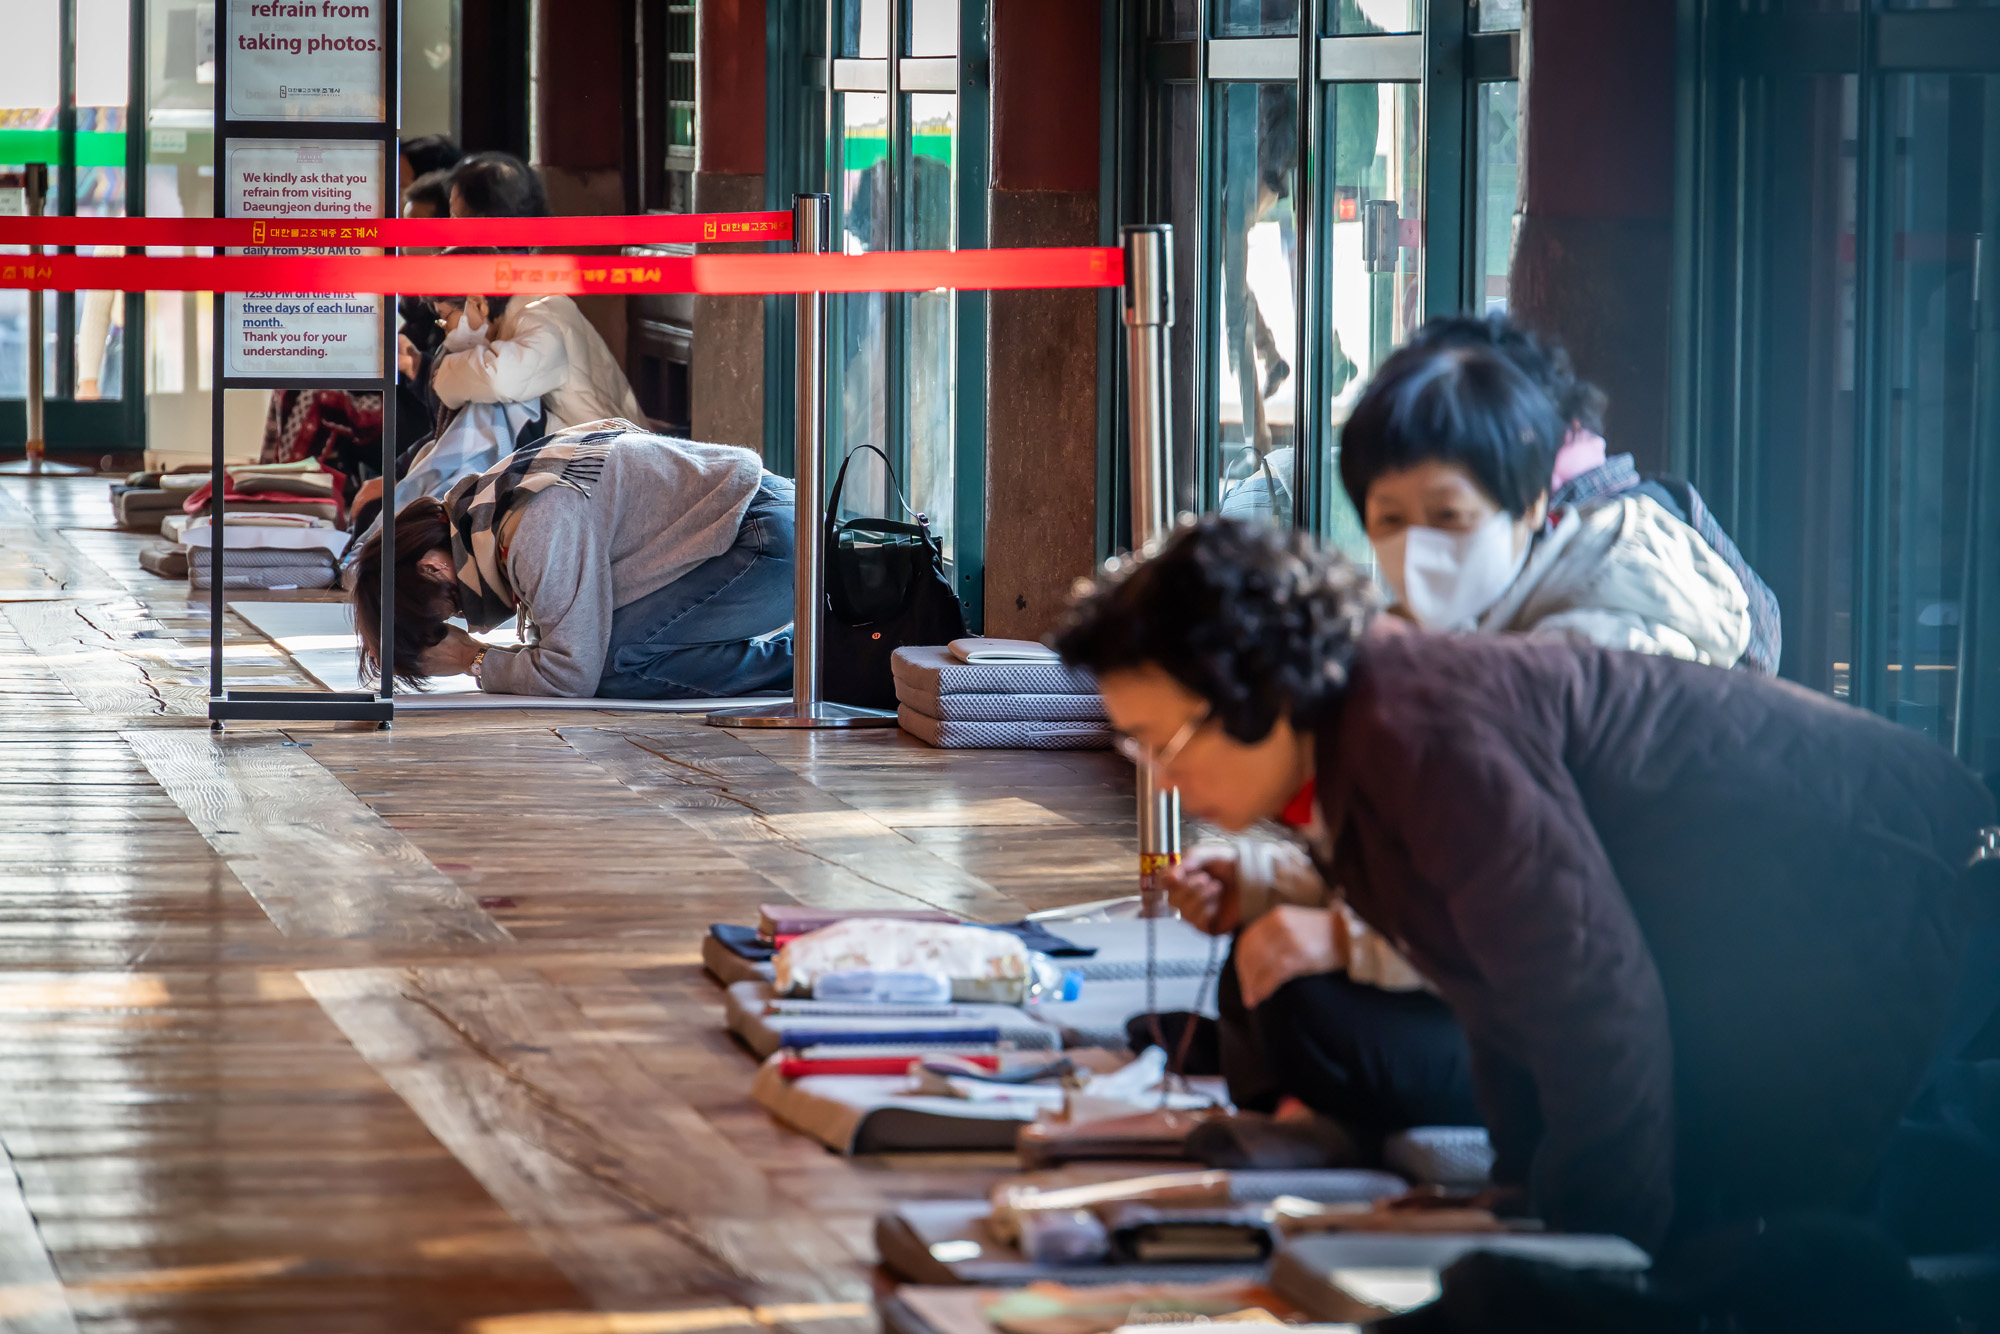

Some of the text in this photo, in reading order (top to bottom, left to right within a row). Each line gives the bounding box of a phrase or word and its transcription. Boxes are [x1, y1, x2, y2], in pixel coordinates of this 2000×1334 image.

[251, 0, 370, 18] refrain from
[238, 33, 302, 55] taking
[307, 33, 383, 55] photos.
[242, 172, 367, 186] We kindly ask that you
[242, 186, 352, 200] refrain from visiting
[242, 201, 372, 215] Daeungjeon during the
[270, 227, 379, 239] 대한불교조계종 조계사
[242, 246, 361, 256] daily from 9:30 AM to
[275, 291, 292, 299] PM
[295, 291, 309, 299] on
[242, 302, 374, 315] three days of each lunar
[242, 317, 284, 327] month.
[242, 331, 347, 344] Thank you for your
[242, 346, 328, 359] understanding.
